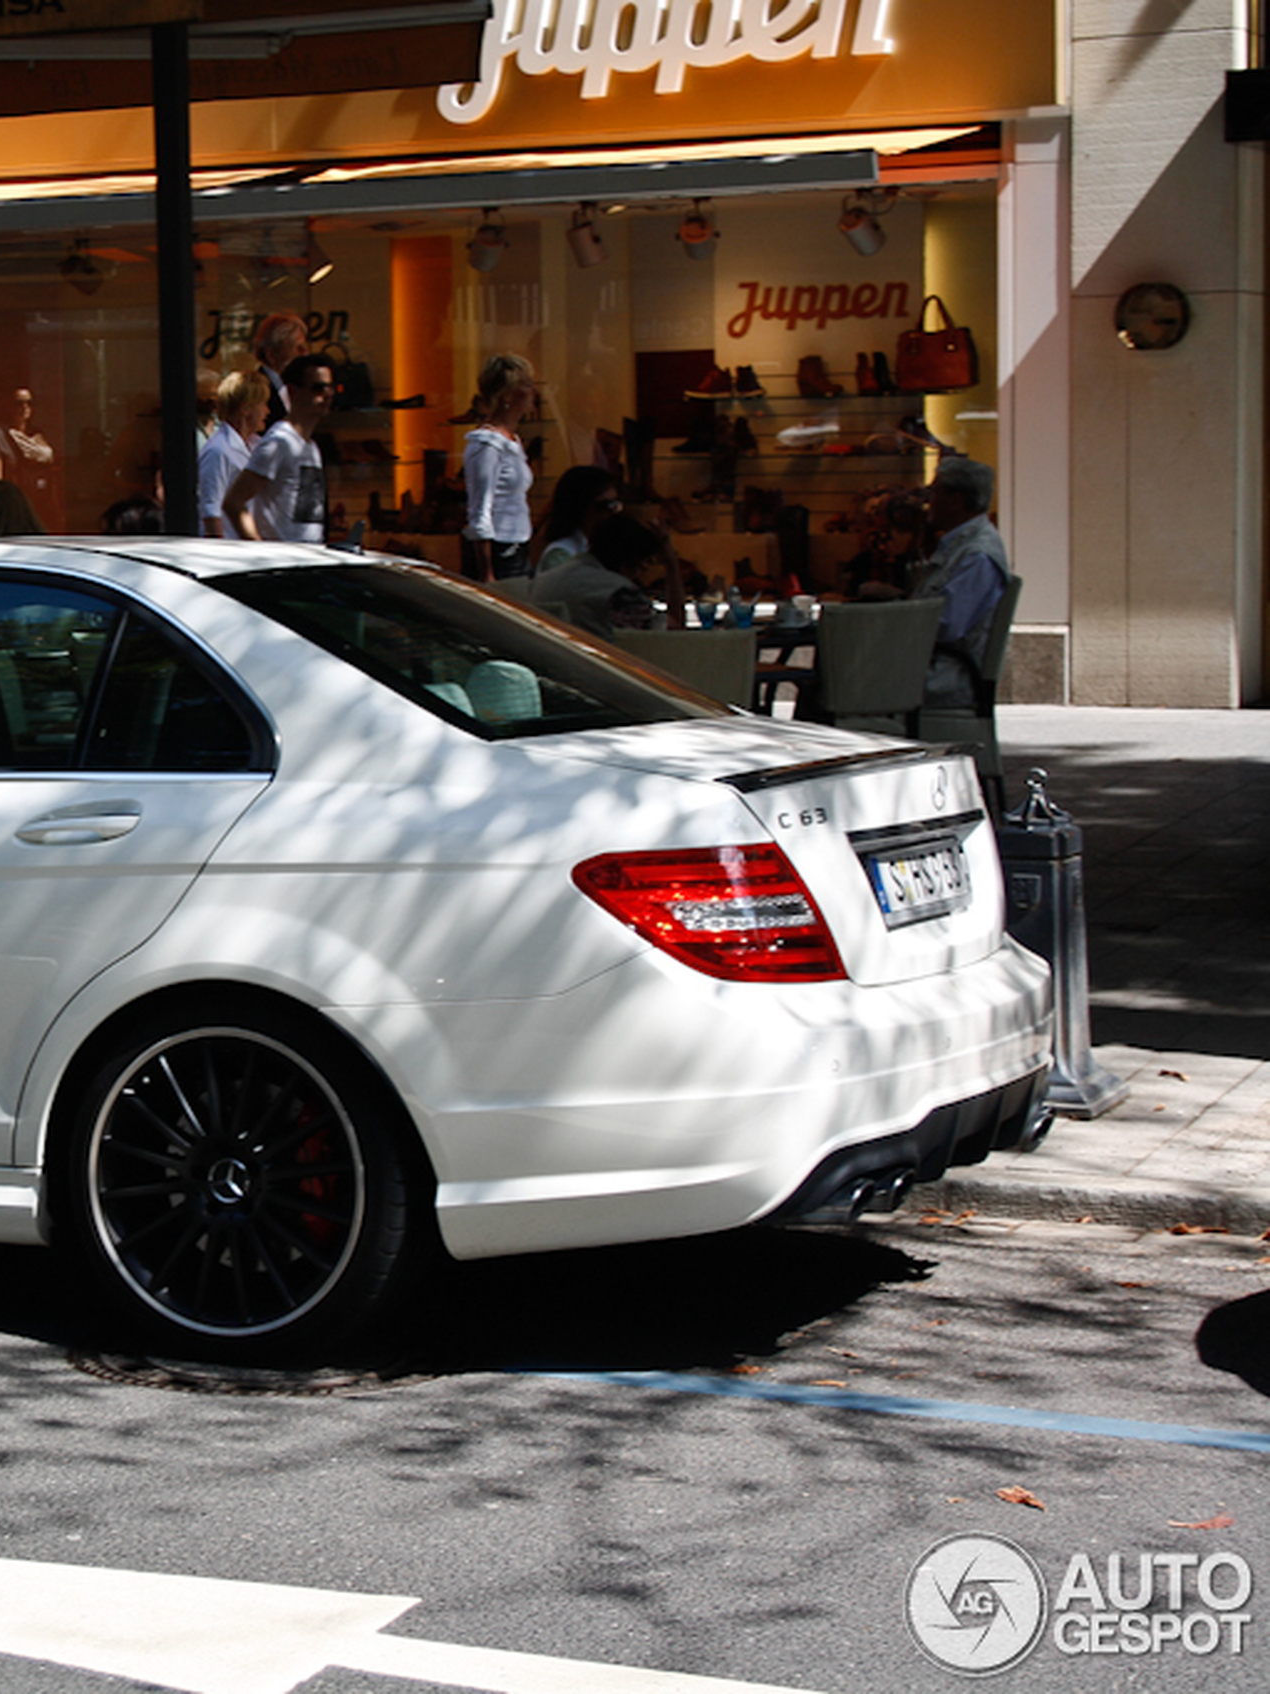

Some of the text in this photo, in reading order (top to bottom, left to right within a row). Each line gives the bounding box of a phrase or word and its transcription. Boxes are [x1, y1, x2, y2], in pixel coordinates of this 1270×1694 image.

[437, 0, 894, 124] Juppen
[728, 281, 909, 337] Juppen
[778, 807, 828, 829] C 63
